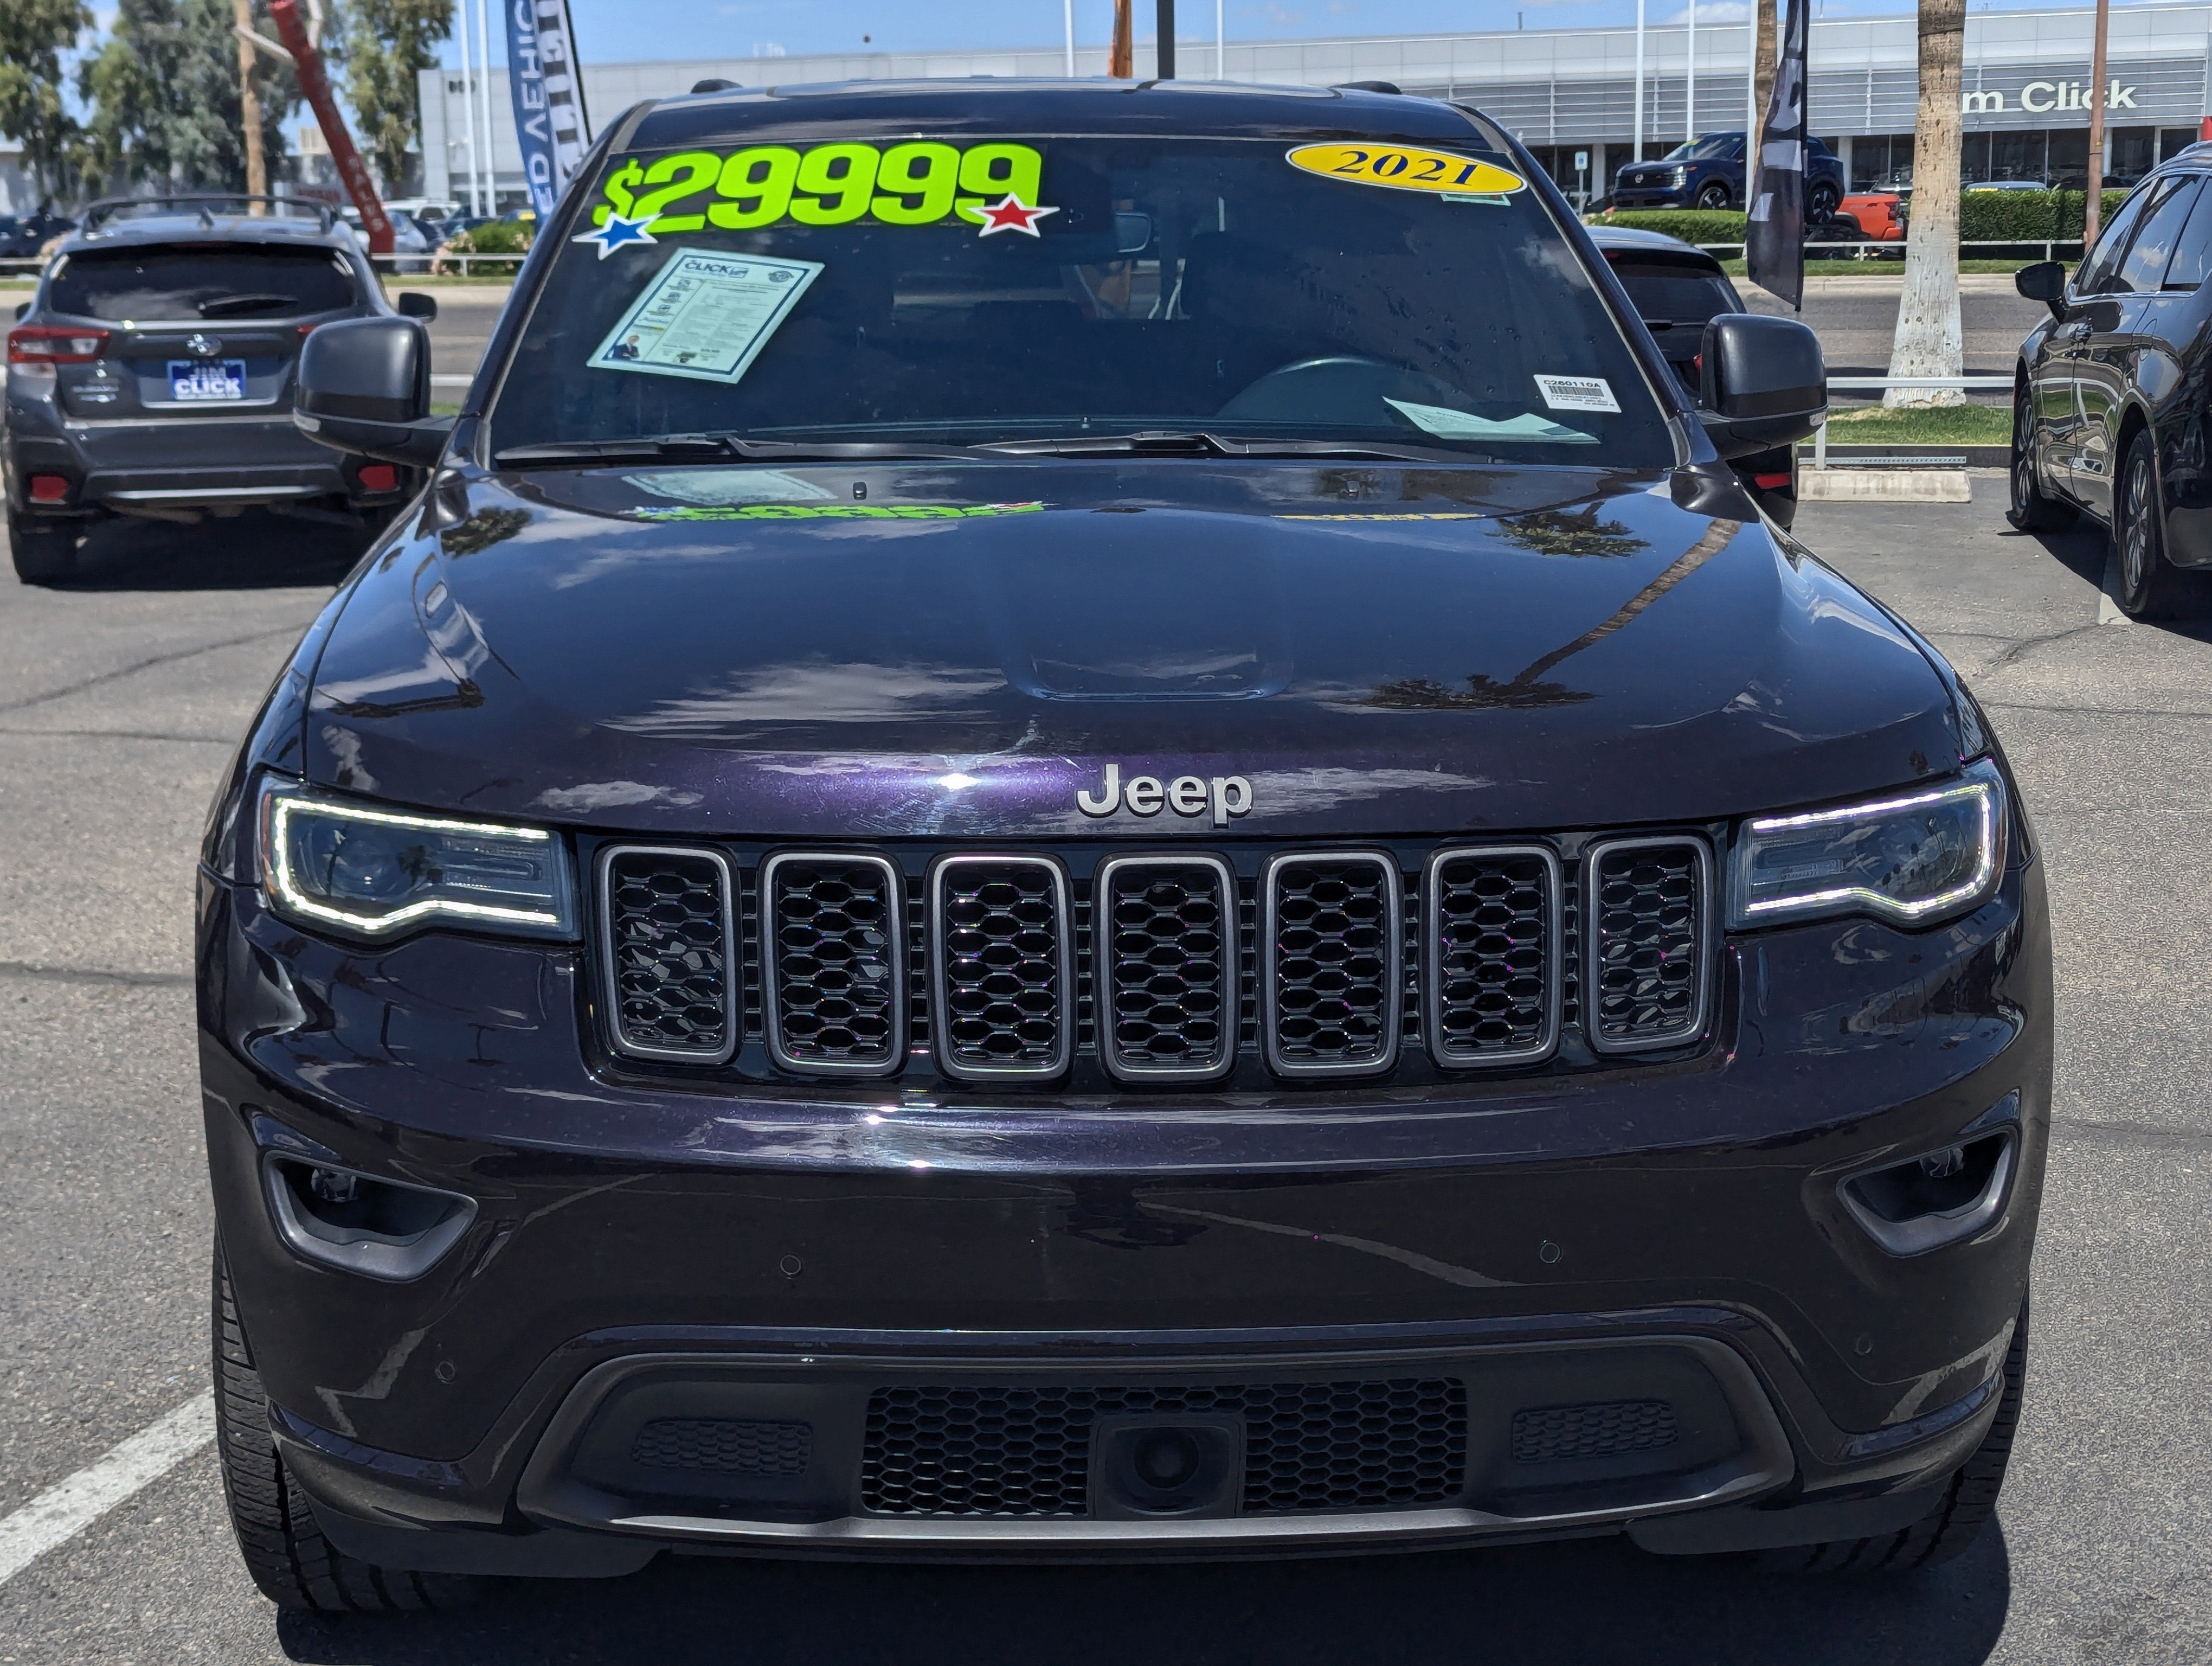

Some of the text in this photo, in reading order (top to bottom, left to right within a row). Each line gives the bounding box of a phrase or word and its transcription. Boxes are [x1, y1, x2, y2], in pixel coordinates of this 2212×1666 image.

[2021, 80, 2138, 113] Click
[1330, 150, 1479, 187] 2021
[592, 141, 1043, 234] $29999
[684, 262, 729, 274] CLICK
[174, 377, 241, 394] CLICK
[1076, 764, 1253, 829] Jeep
